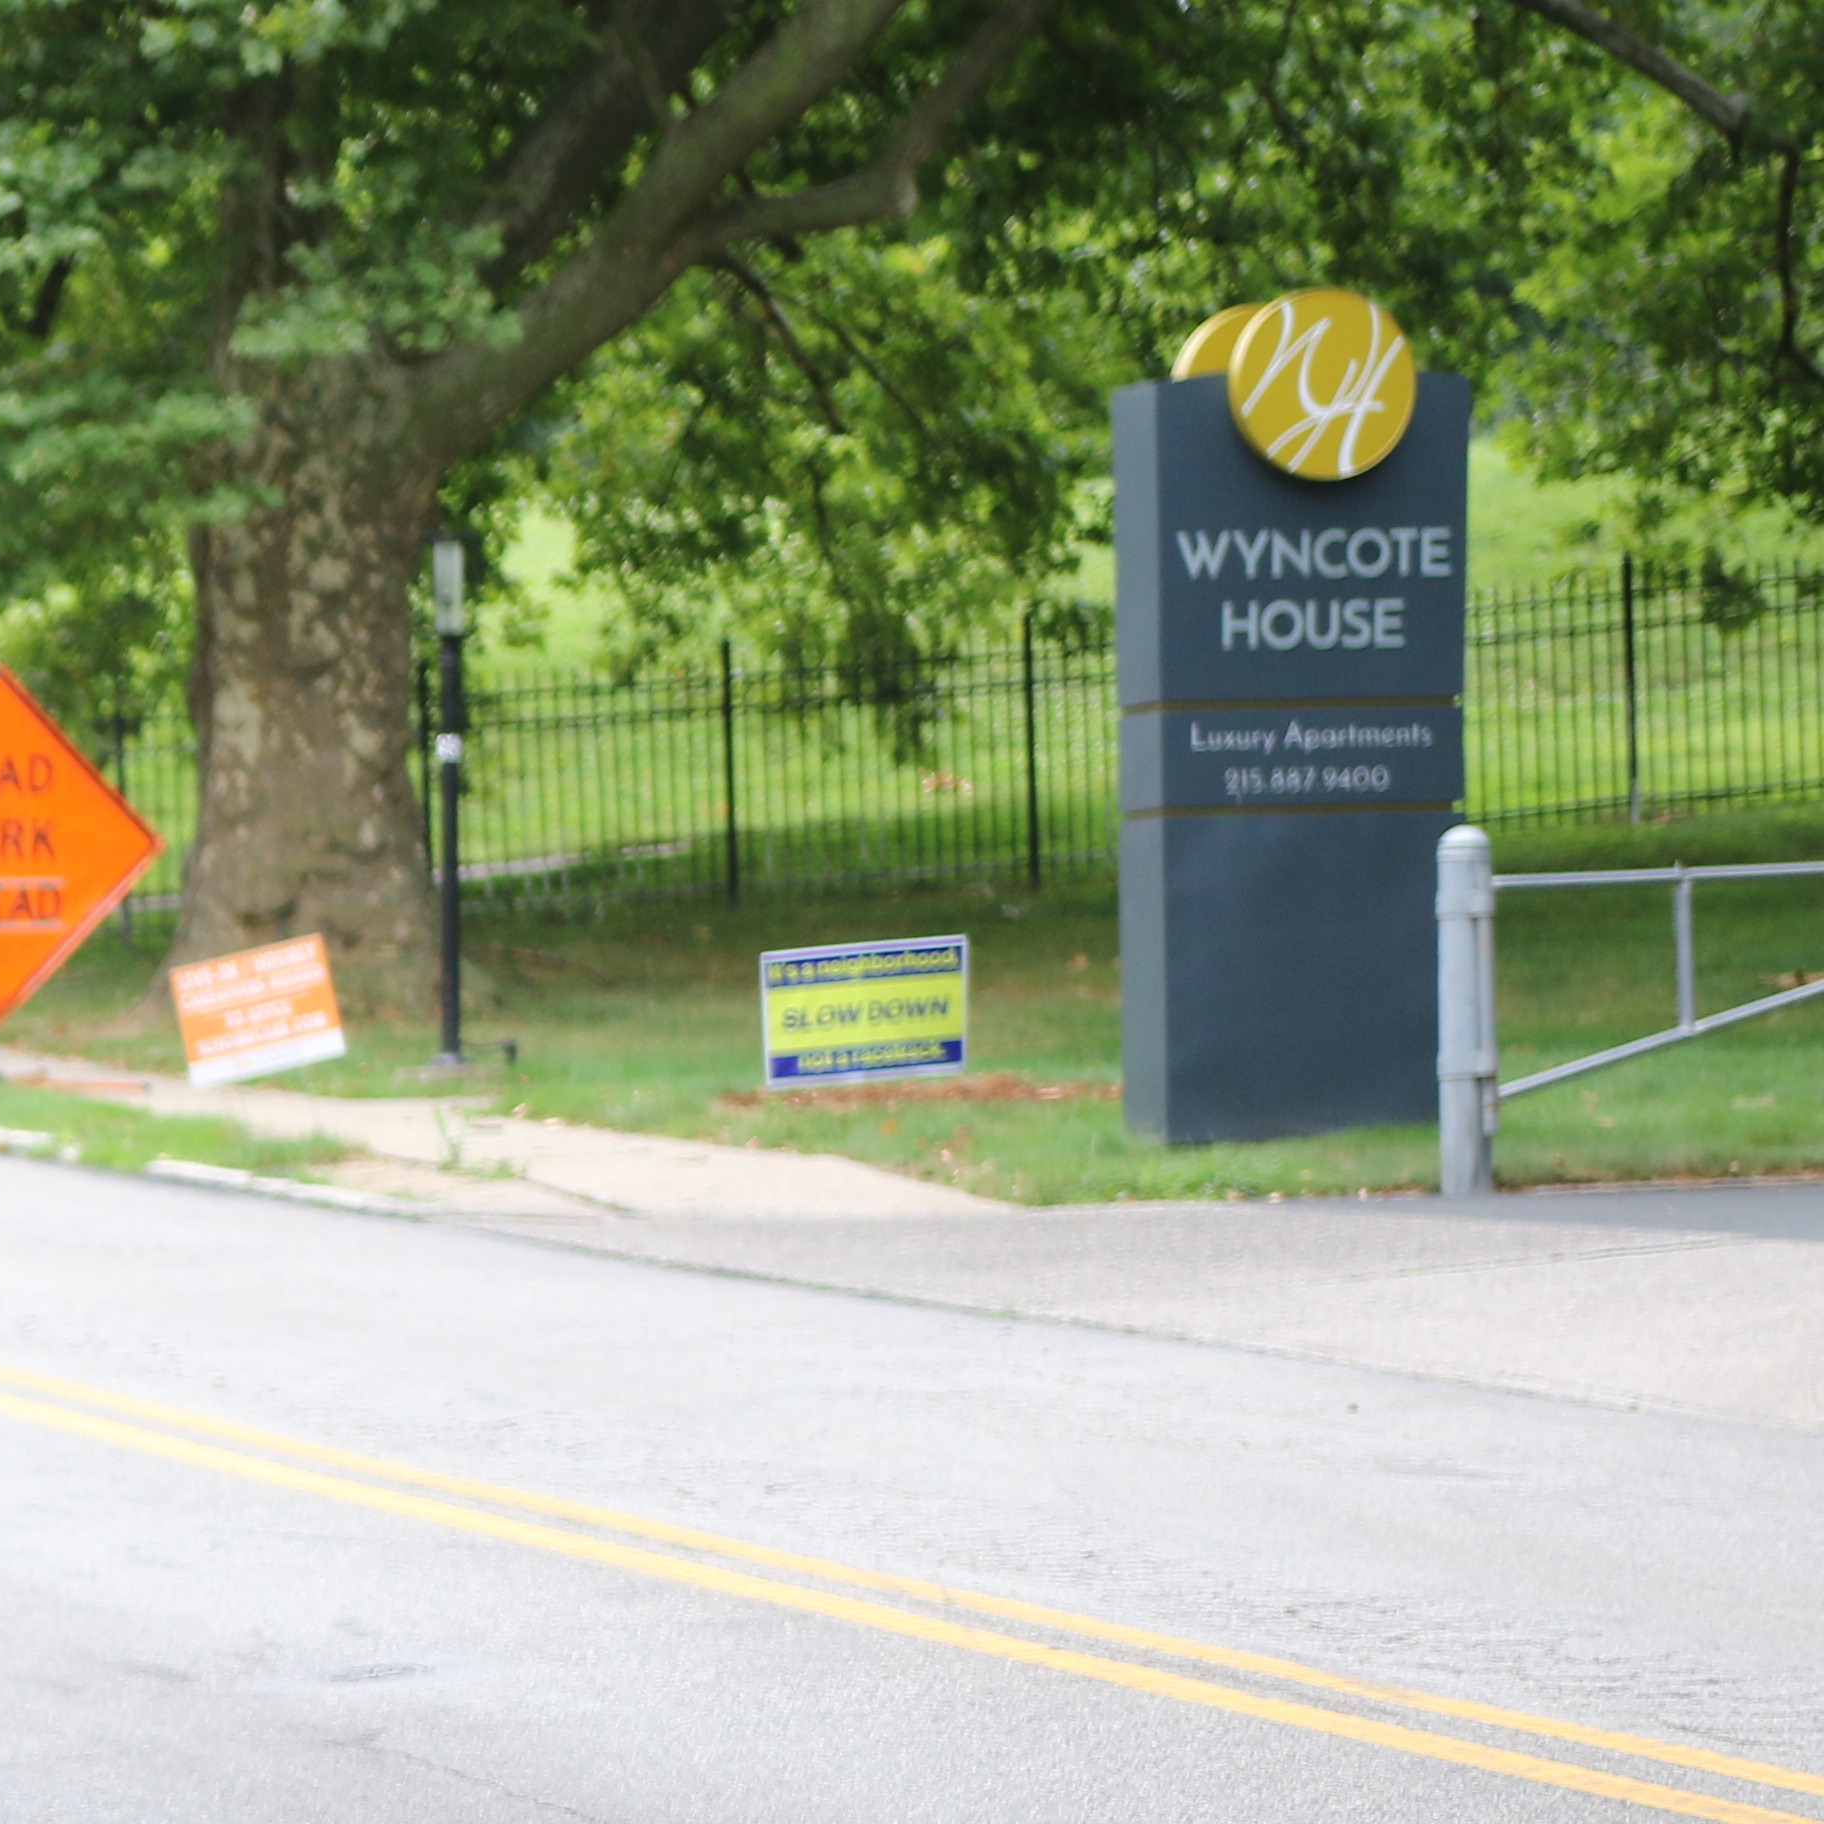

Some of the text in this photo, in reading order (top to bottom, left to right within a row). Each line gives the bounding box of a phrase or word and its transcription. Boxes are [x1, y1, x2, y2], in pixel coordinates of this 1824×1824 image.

[1176, 527, 1451, 579] WYNCOTE
[1222, 598, 1405, 651] HOUSE
[1190, 720, 1434, 755] Luxury Apartments
[801, 962, 815, 980] a
[783, 997, 950, 1029] SLOW DOWN
[836, 1051, 849, 1069] a
